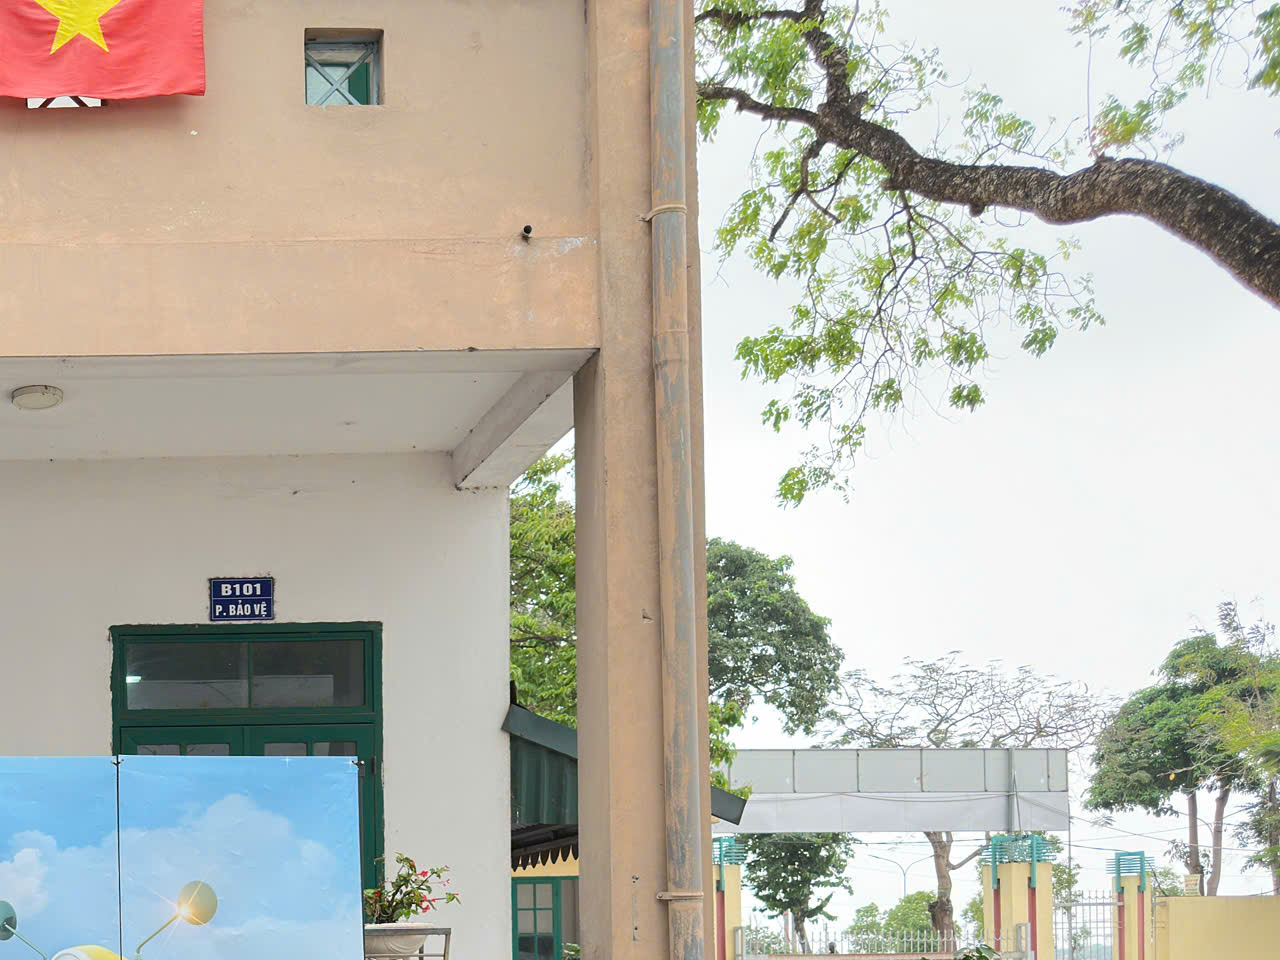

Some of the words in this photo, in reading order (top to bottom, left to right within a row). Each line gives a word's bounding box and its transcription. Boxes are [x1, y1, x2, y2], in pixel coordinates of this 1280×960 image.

[221, 583, 262, 596] B101
[228, 599, 252, 616] BẢO
[253, 601, 268, 617] VỆ
